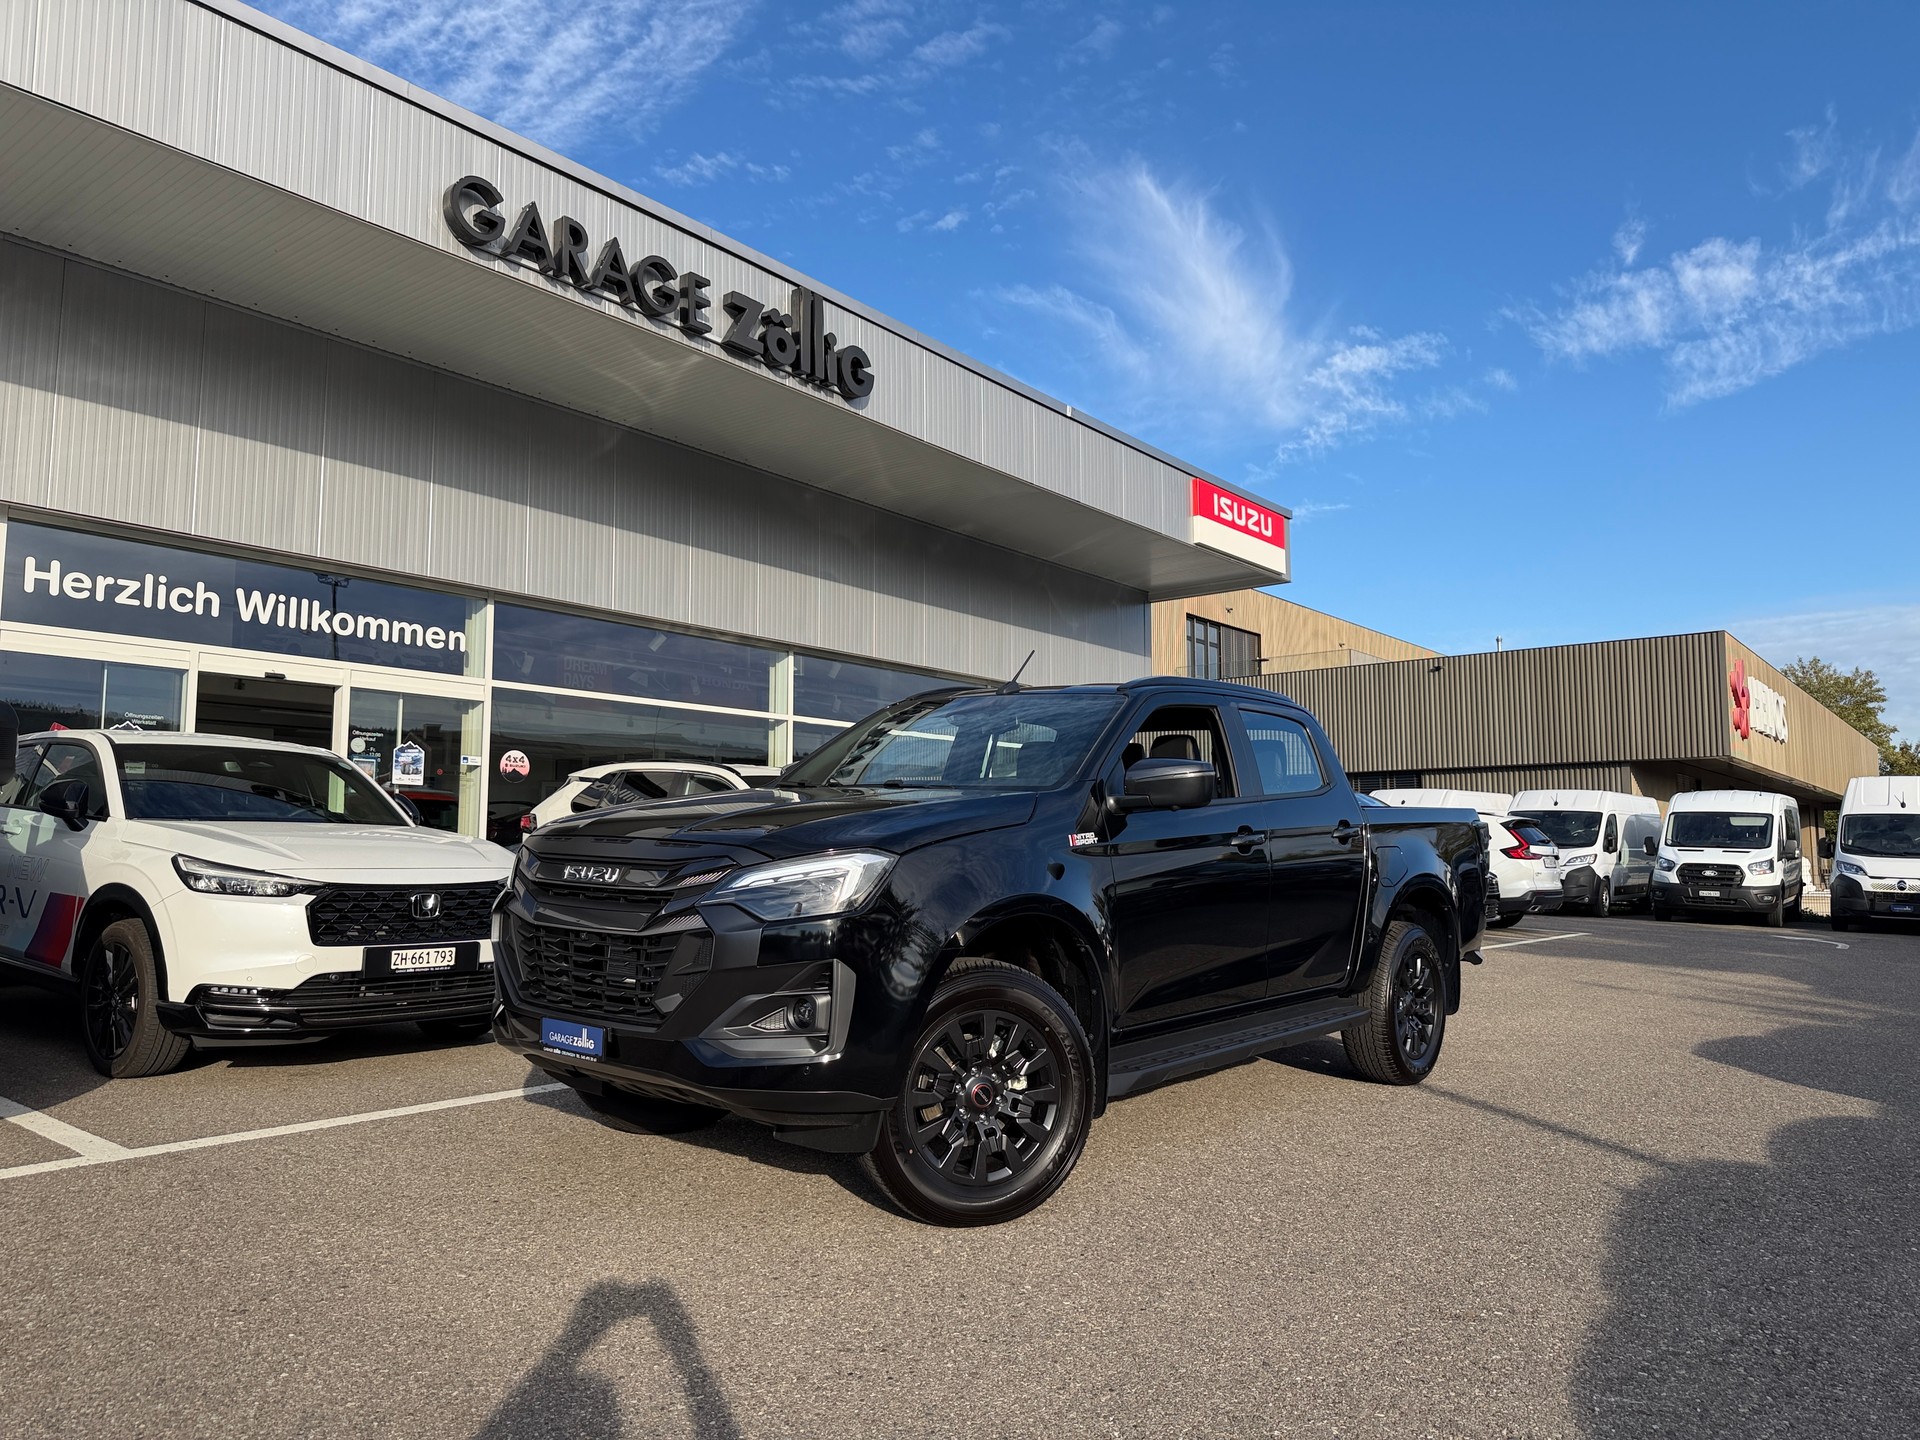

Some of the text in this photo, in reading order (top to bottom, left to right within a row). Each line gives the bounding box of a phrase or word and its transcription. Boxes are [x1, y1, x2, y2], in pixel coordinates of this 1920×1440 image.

[443, 175, 712, 335] GARAGE
[1213, 493, 1273, 538] ISUZU
[23, 556, 467, 652] Herzlich Willkommen
[564, 656, 608, 675] DREAM
[564, 672, 595, 689] DAYS
[702, 677, 751, 691] HONDA
[124, 711, 165, 720] Öffnungszeiten
[131, 718, 157, 726] Werkstatt
[505, 755, 525, 764] 4x4
[7, 854, 50, 882] NEW
[563, 865, 620, 883] ISUZU
[549, 1031, 573, 1045] GARAGE
